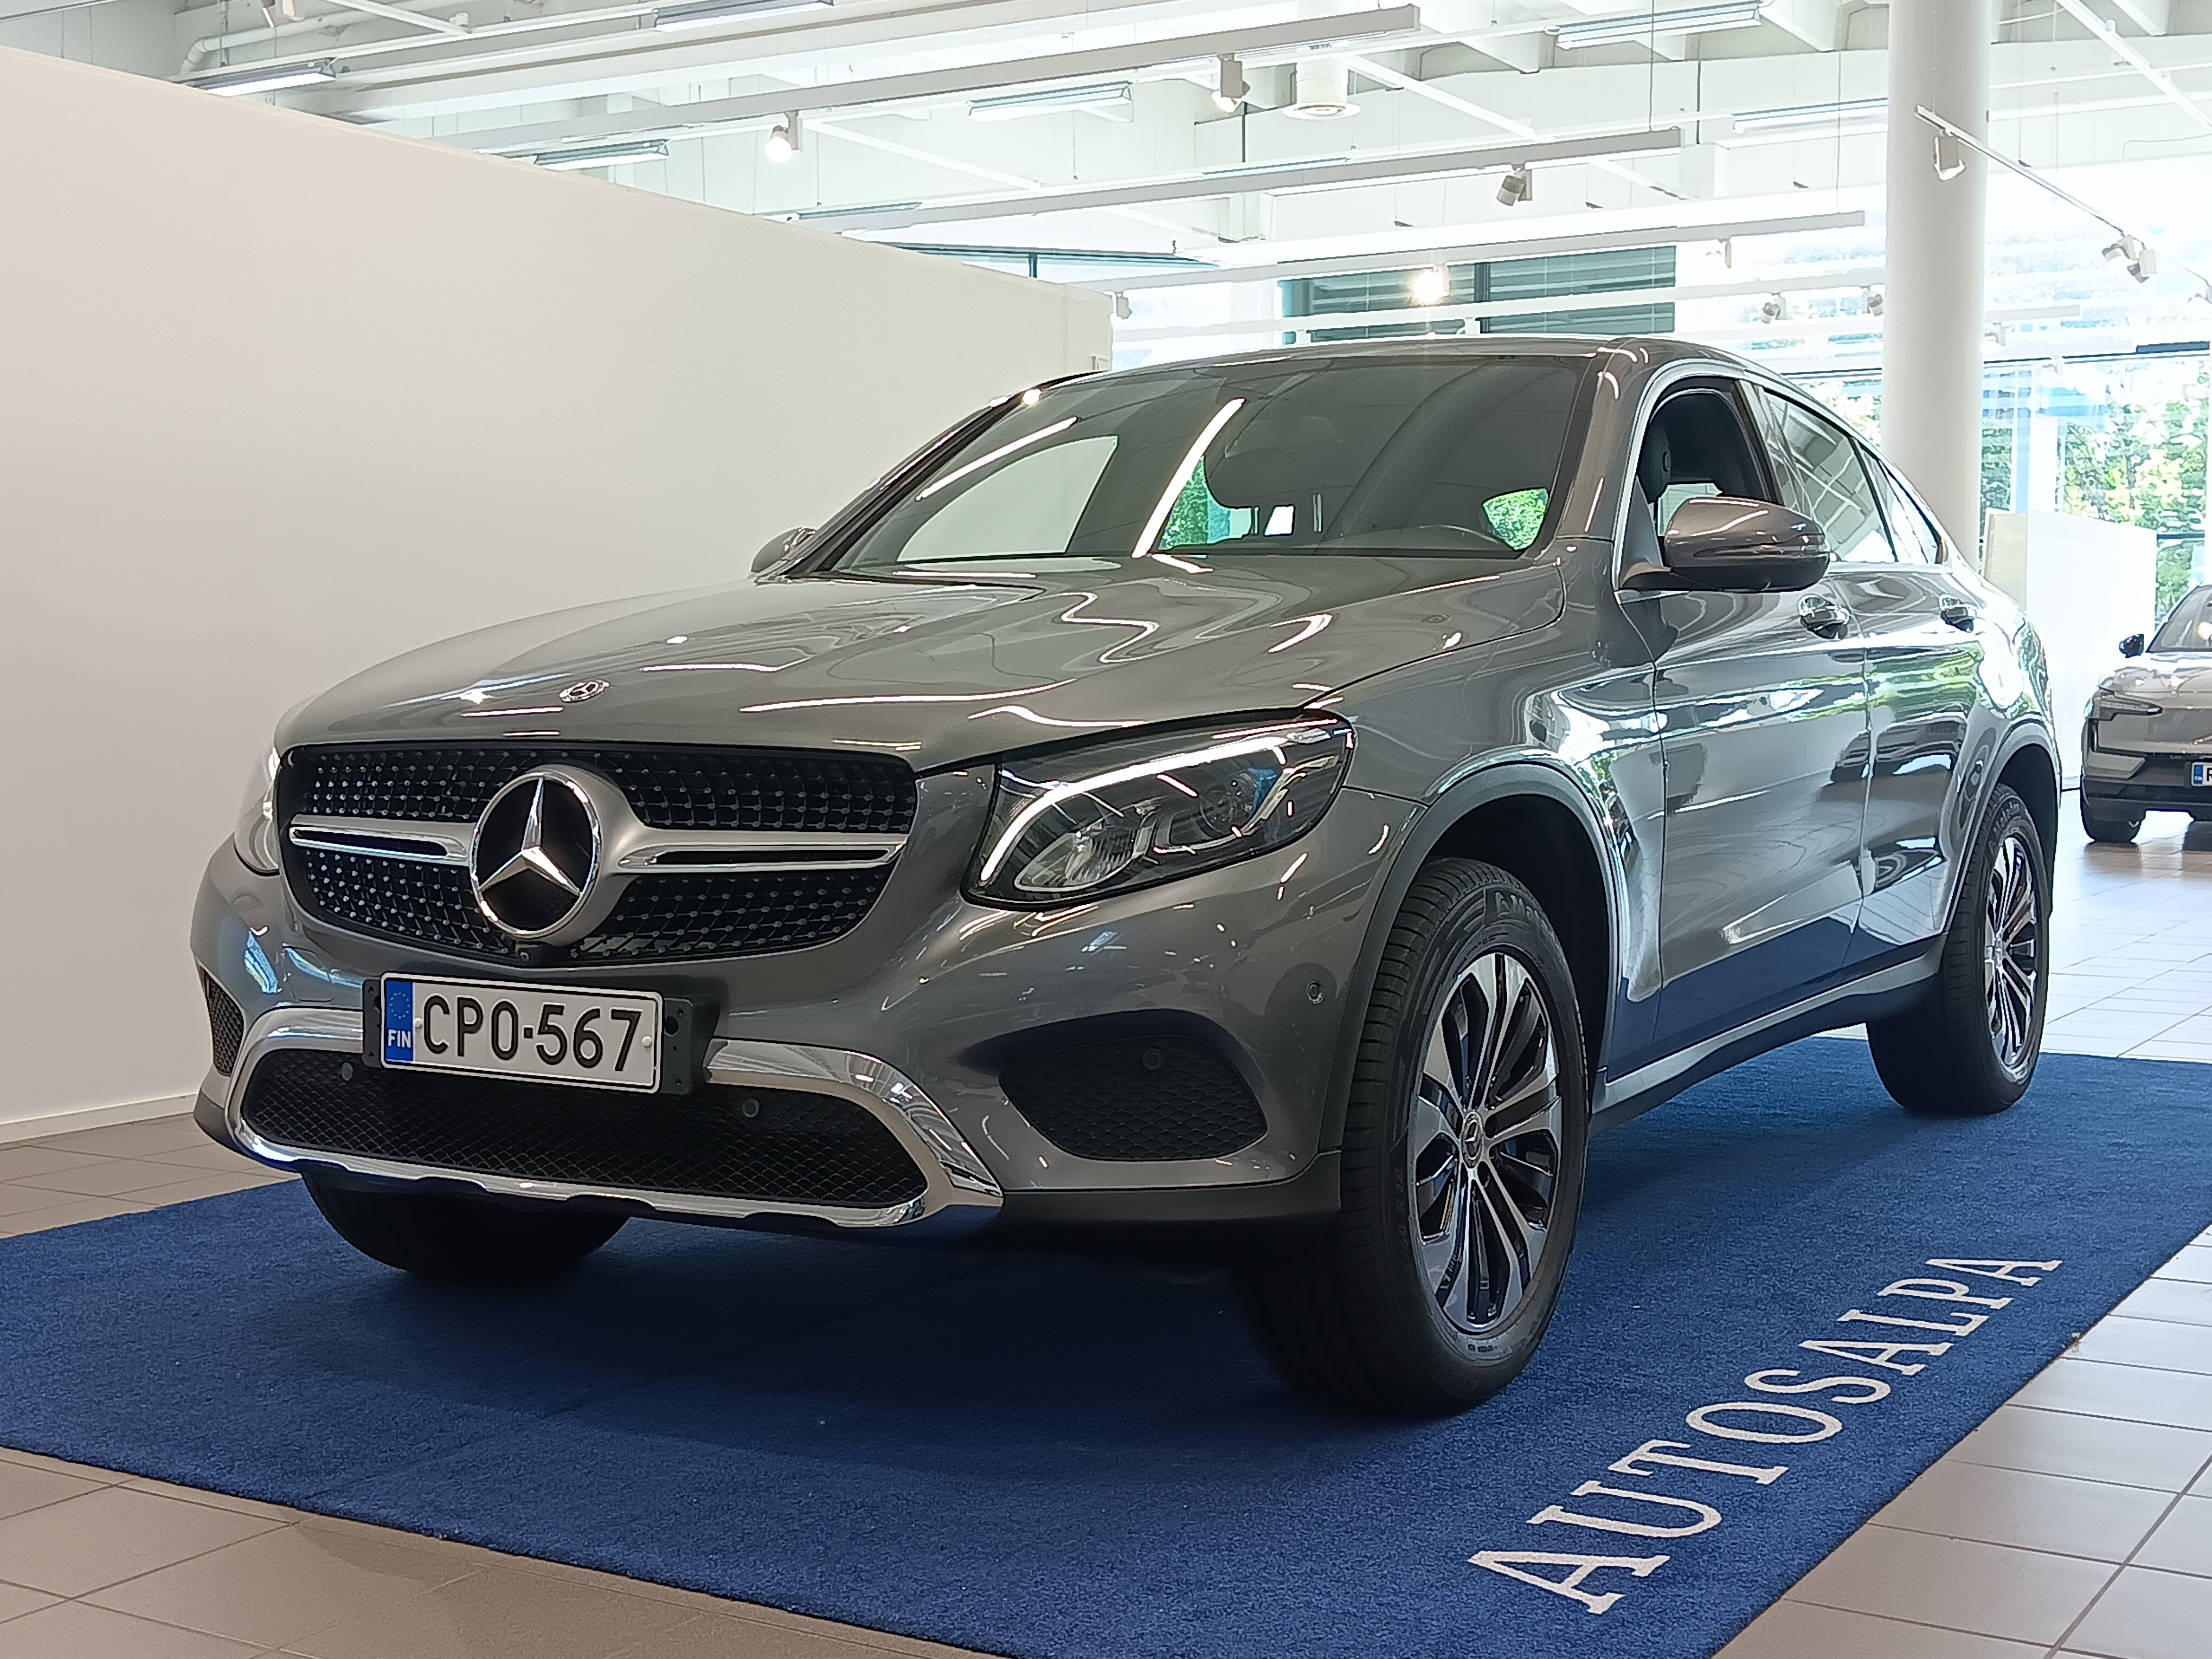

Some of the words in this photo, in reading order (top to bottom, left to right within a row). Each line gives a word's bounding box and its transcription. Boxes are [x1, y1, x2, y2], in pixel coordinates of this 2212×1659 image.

[388, 1029, 411, 1048] FIN
[423, 995, 642, 1072] CPO-567
[1467, 1258, 2063, 1615] AUTOSALPA
